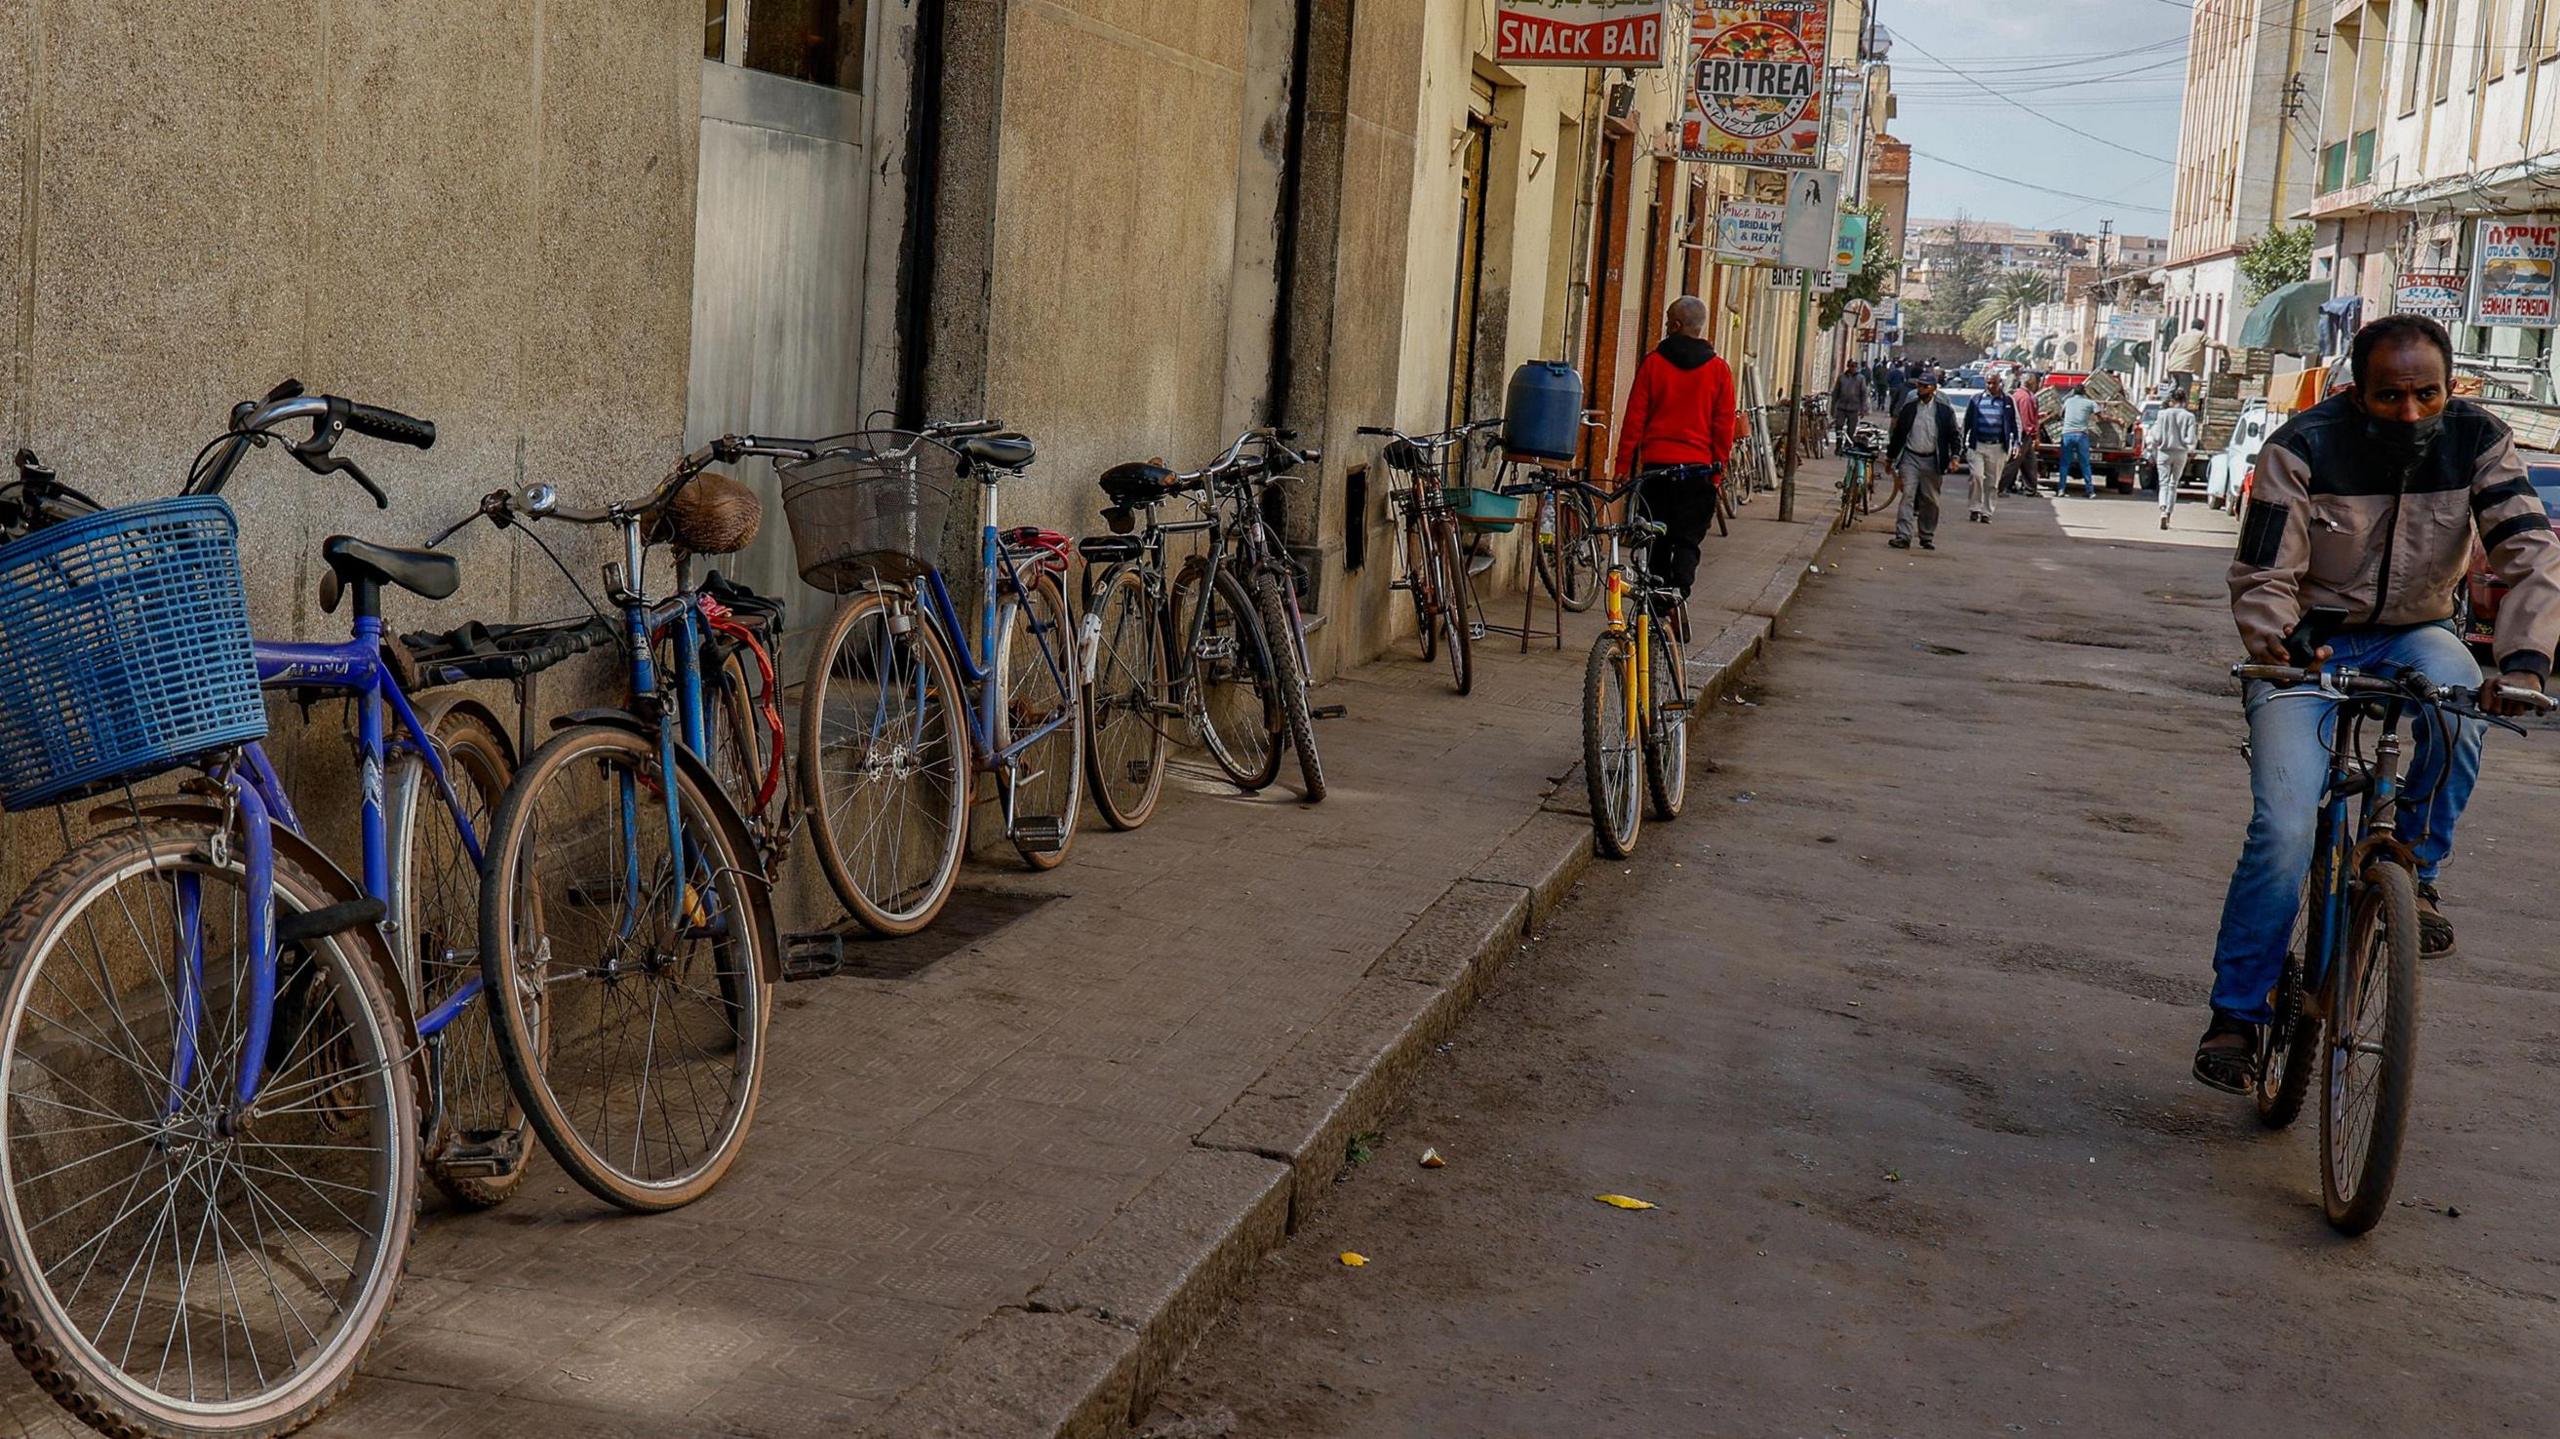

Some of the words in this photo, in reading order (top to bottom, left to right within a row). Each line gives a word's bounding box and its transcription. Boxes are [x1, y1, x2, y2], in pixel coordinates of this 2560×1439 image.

[1500, 19, 1592, 55] SNACK
[1602, 19, 1657, 56] BAR
[1698, 60, 1809, 97] ERITREA
[1710, 106, 1794, 136] PIZZERIA
[1757, 154, 1815, 166] SERVICE
[1738, 219, 1769, 231] BRIDAL
[1740, 231, 1748, 241] &
[1751, 233, 1782, 243] RENT
[1772, 268, 1794, 286] BATH
[1796, 269, 1832, 287] SVICE
[2396, 308, 2433, 317] SNACK
[2436, 308, 2460, 318] BAR
[2482, 297, 2512, 315] SEMHAR
[2515, 298, 2550, 317] PENSION
